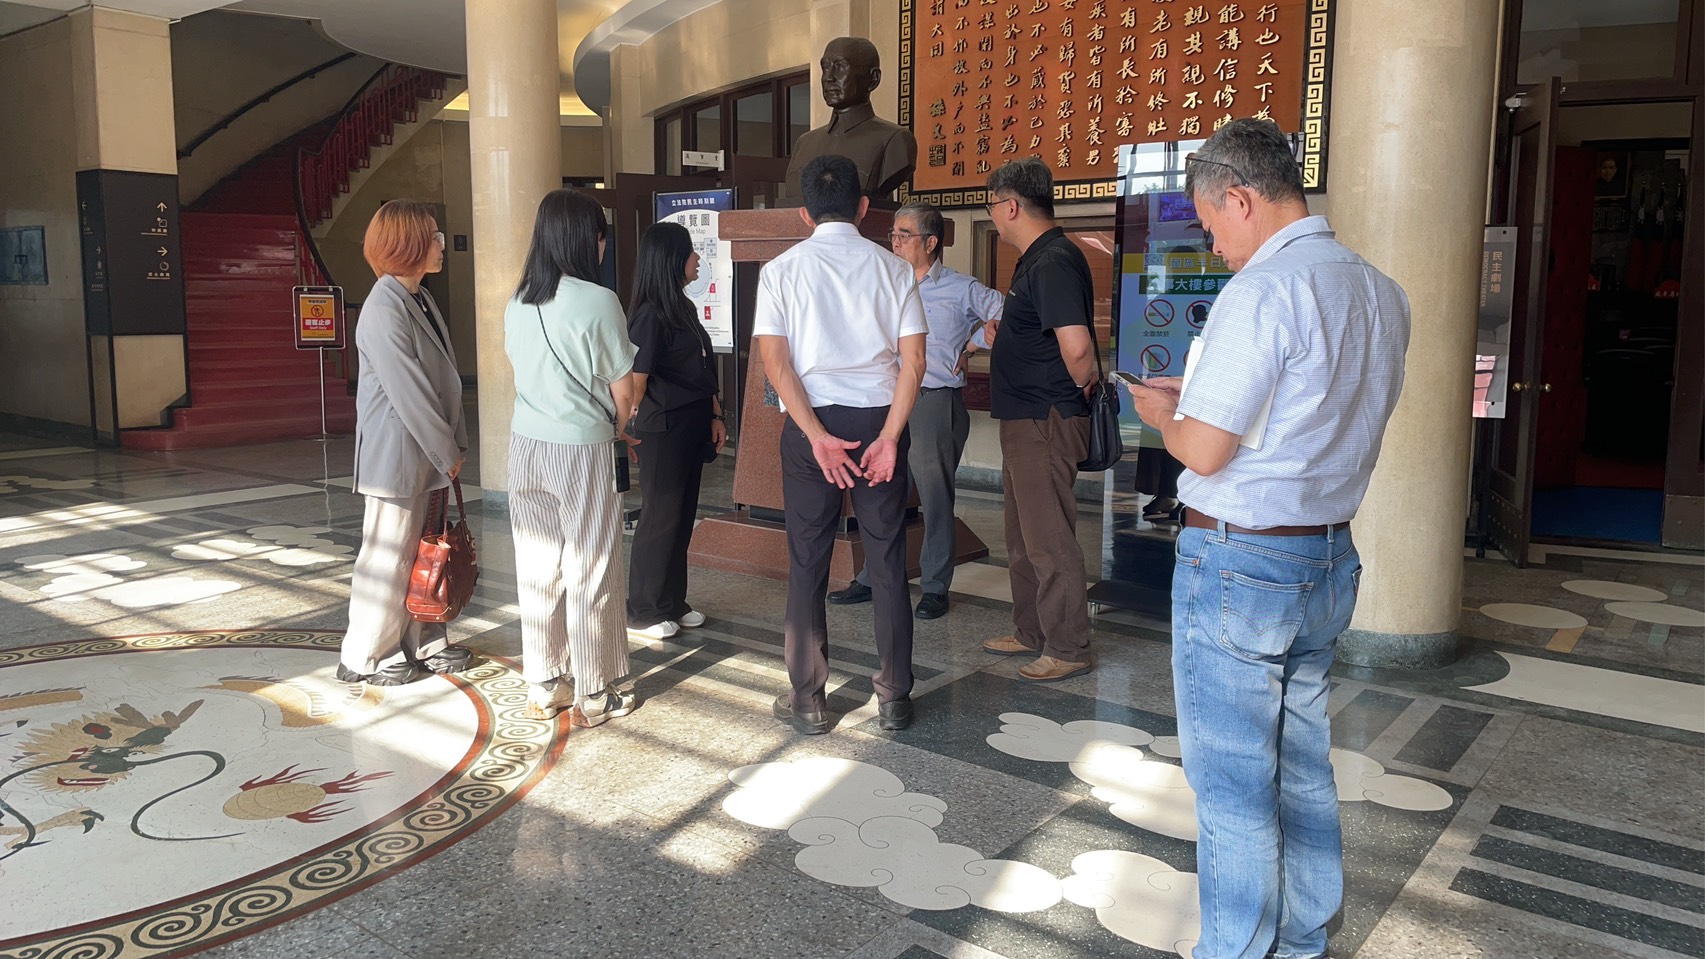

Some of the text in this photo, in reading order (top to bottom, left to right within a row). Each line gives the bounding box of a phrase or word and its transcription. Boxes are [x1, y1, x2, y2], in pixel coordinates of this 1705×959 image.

[1112, 0, 1139, 163] 有所長矜寡
[1147, 0, 1172, 136] 老有所終壯
[1170, 257, 1228, 269] 園區半日
